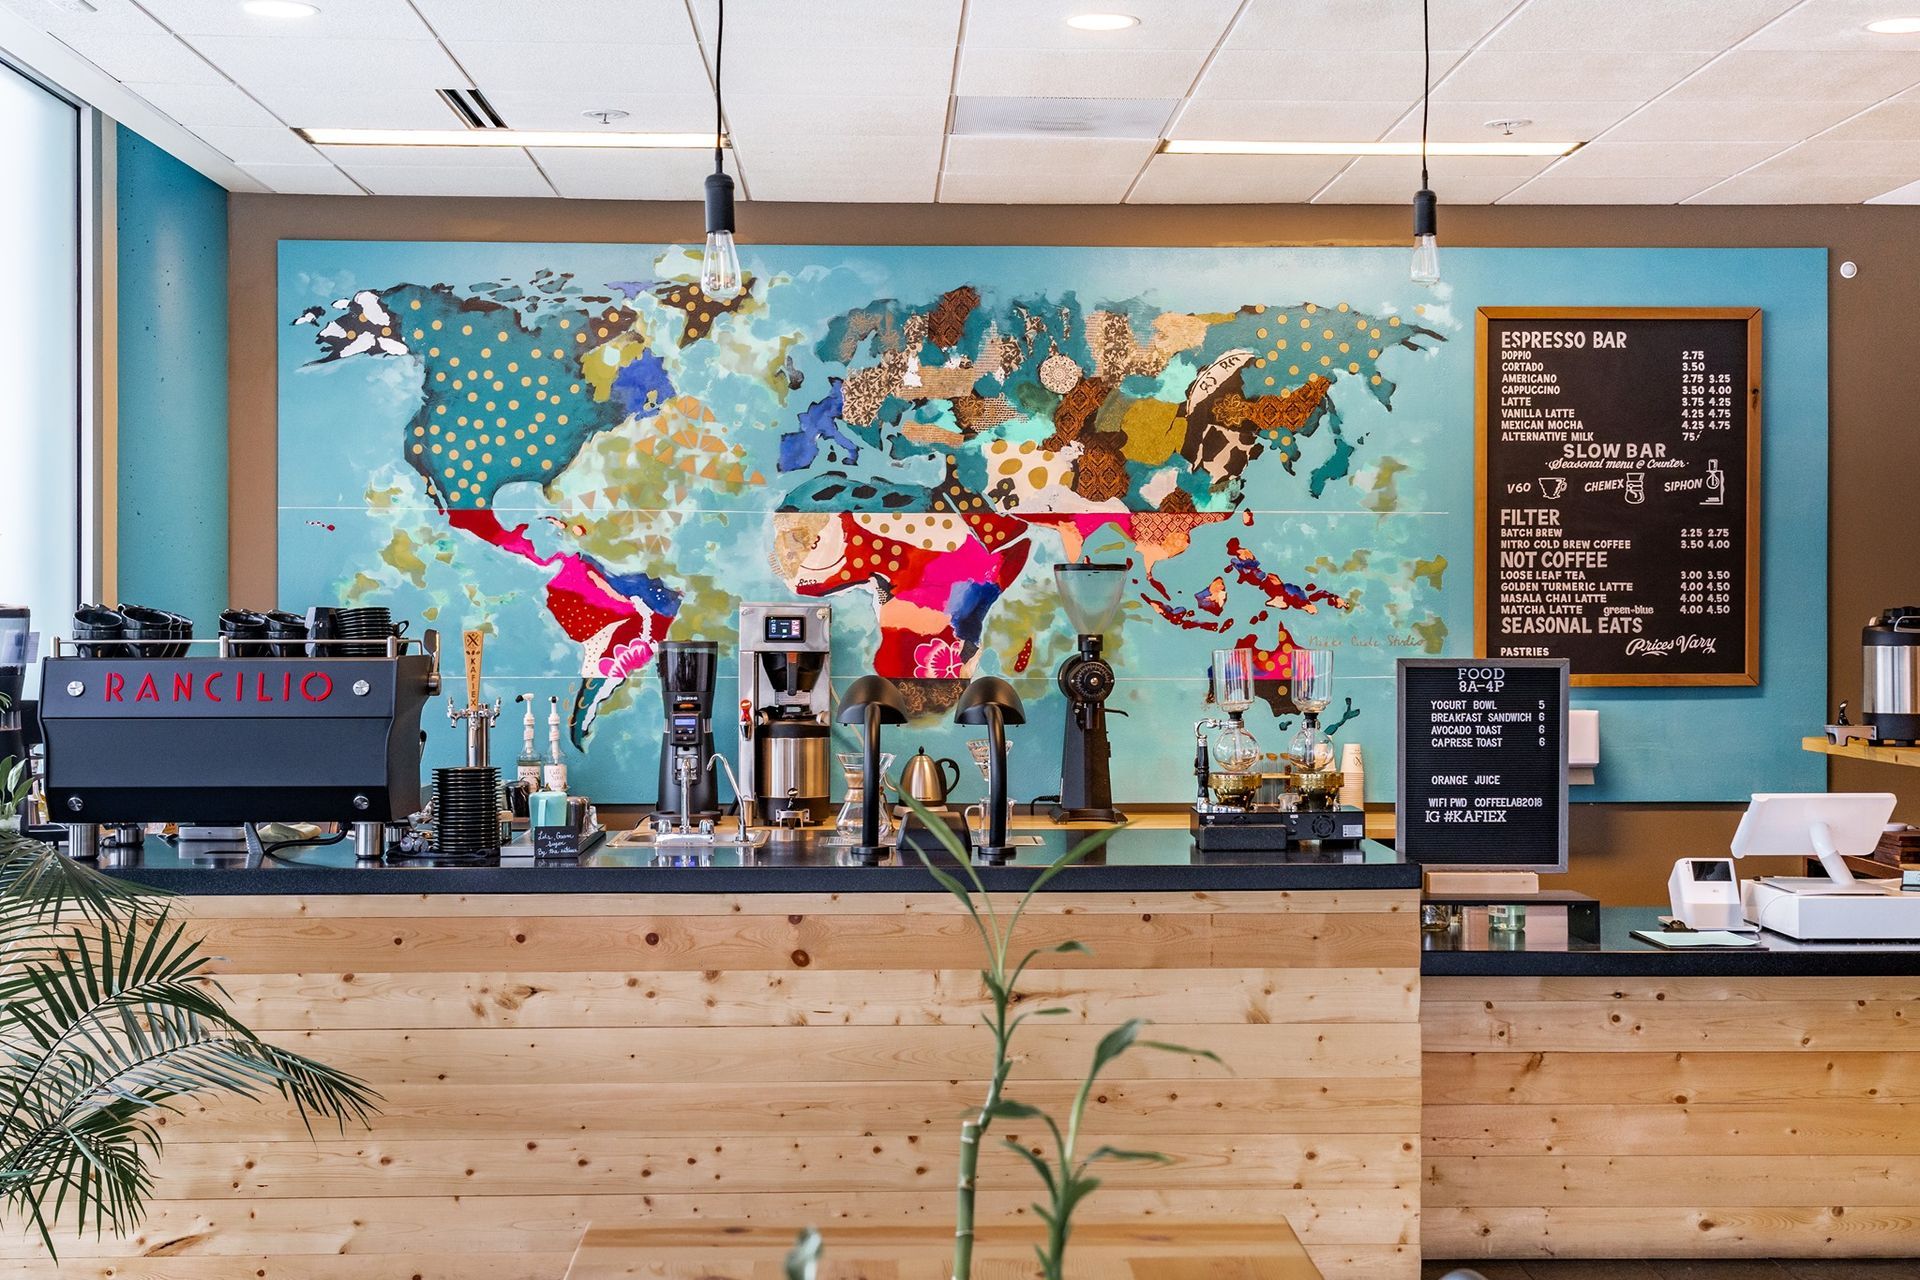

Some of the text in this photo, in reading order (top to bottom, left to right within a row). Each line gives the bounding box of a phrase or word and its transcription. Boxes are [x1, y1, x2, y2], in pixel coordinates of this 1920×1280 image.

[1502, 331, 1627, 348] ESPRESSO BAR
[1502, 351, 1704, 360] DOPPIO 2.75
[1502, 362, 1705, 371] CORTADO 3.50
[1502, 374, 1730, 383] AMERICANO 2.75 3.25
[1502, 385, 1731, 395] CAPPUCCINO 3.50 4.00
[1502, 397, 1731, 406] LATTE 3.75 4.25
[1502, 409, 1731, 418] VANILLA LATTE 4.25 4.75
[1501, 420, 1730, 430] MEXICAN MOCHA 4.25 4.75
[1502, 432, 1567, 441] ALTERNATIVE
[1571, 432, 1593, 441] MILK
[1563, 443, 1666, 459] SLOW BAR
[1548, 458, 1686, 470] Seasonal menu @ Counter
[1507, 482, 1531, 493] V60
[1584, 478, 1625, 492] CHEMEX
[1664, 478, 1703, 492] SIPHON
[1501, 509, 1560, 525] FILTER
[1501, 528, 1729, 537] BATCH BREW 2.25 2.75
[1501, 540, 1729, 549] NITRO COLD BREW COFFEE 3.50 4.00
[1501, 551, 1607, 568] NOT COFFEE
[1501, 571, 1730, 580] LOOSE LEAF TEA 3.00 3.50
[1501, 582, 1730, 591] GOLDEN TURMERIC LATTE 4.00 4.50
[1501, 594, 1729, 603] MASALA CHAI LATTE 4.00 4.50
[1501, 605, 1545, 614] MATCHA
[1550, 605, 1582, 614] LATTE
[1680, 605, 1703, 614] 4.00
[1707, 605, 1730, 614] 4.50
[1501, 617, 1642, 633] SEASONAL EATS
[1625, 634, 1716, 656] Prices Vary
[1501, 647, 1549, 656] PASTRIES
[1458, 668, 1504, 680] FOOD
[104, 671, 334, 702] RANCILIO
[1459, 681, 1504, 692] 8A-4P
[1431, 700, 1545, 709] YOGURT BOWL 5
[1431, 712, 1544, 722] BREAKFAST SANDWICH 6
[1431, 725, 1545, 735] AVOCADO TOAST 6
[1432, 737, 1545, 747] CAPRESE TOAST 6
[1432, 775, 1500, 784] ORANGE JUICE
[1429, 798, 1542, 807] WIFI PWD COFFEELAB2018
[1425, 810, 1507, 822] IG #KAFIEX
